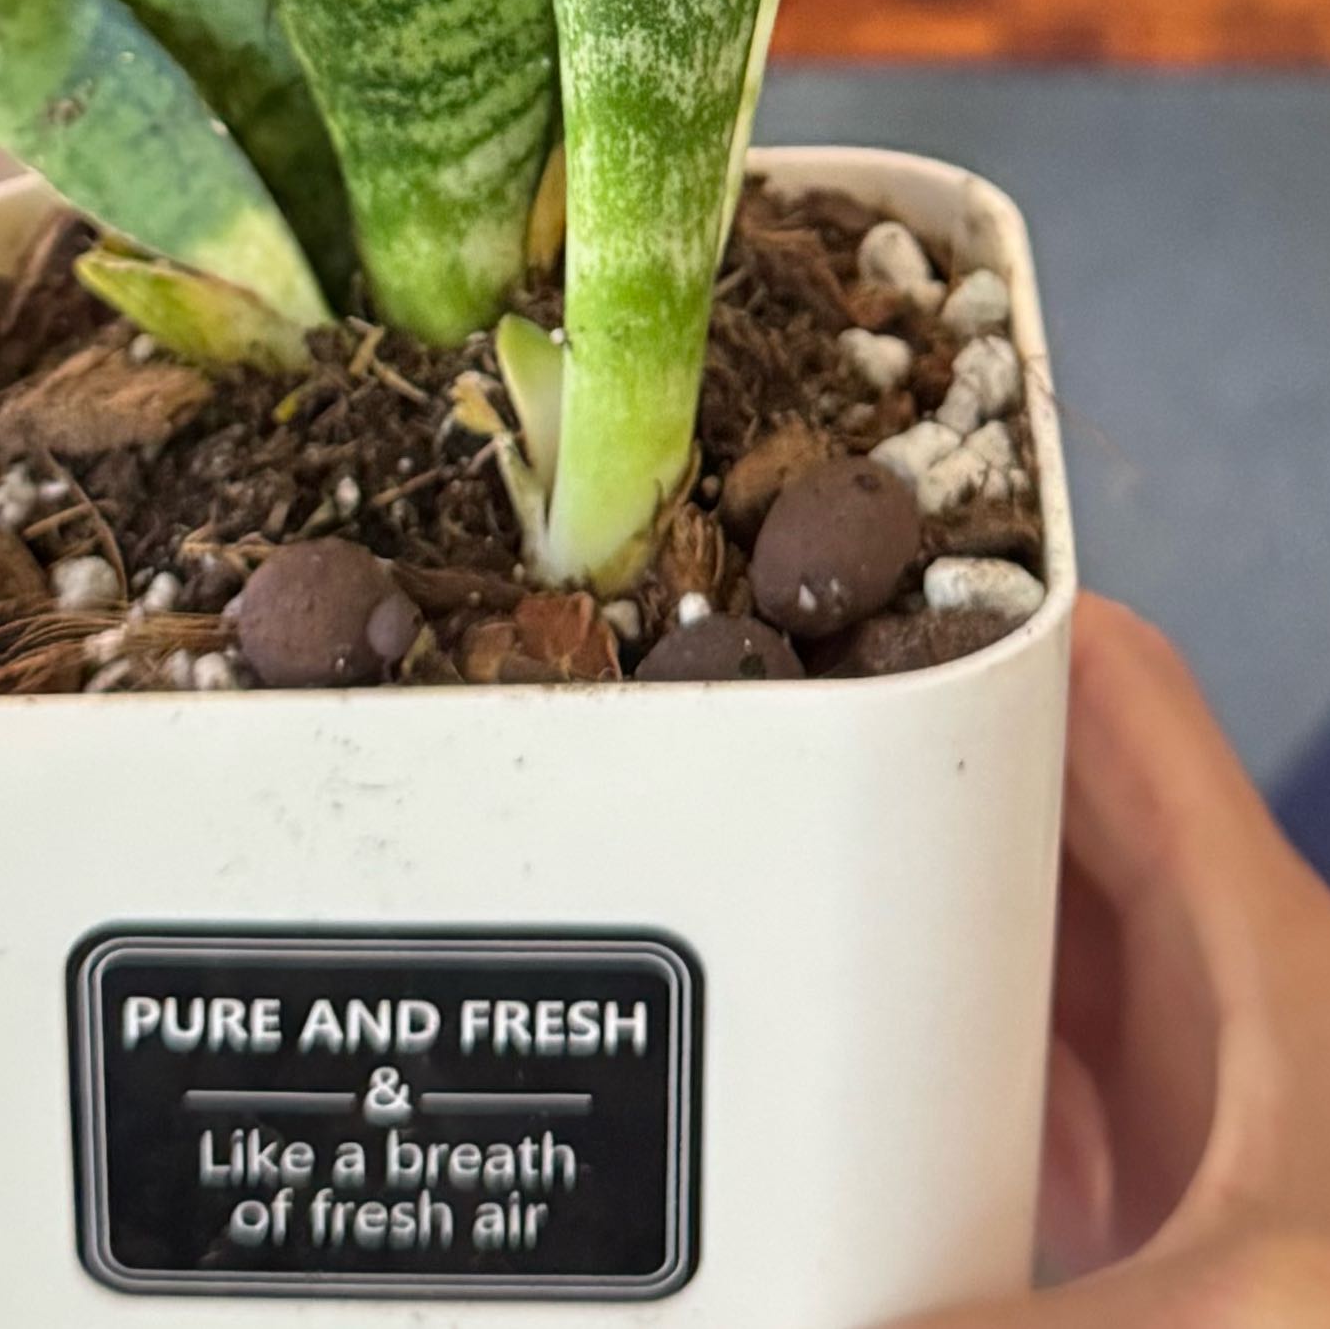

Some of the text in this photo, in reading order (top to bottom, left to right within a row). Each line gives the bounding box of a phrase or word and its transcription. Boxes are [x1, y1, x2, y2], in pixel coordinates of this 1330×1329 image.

[122, 997, 647, 1054] PURE AND FRESH
[363, 1066, 412, 1124] &
[199, 1129, 577, 1190] Like a breath
[230, 1188, 548, 1249] of fresh air
